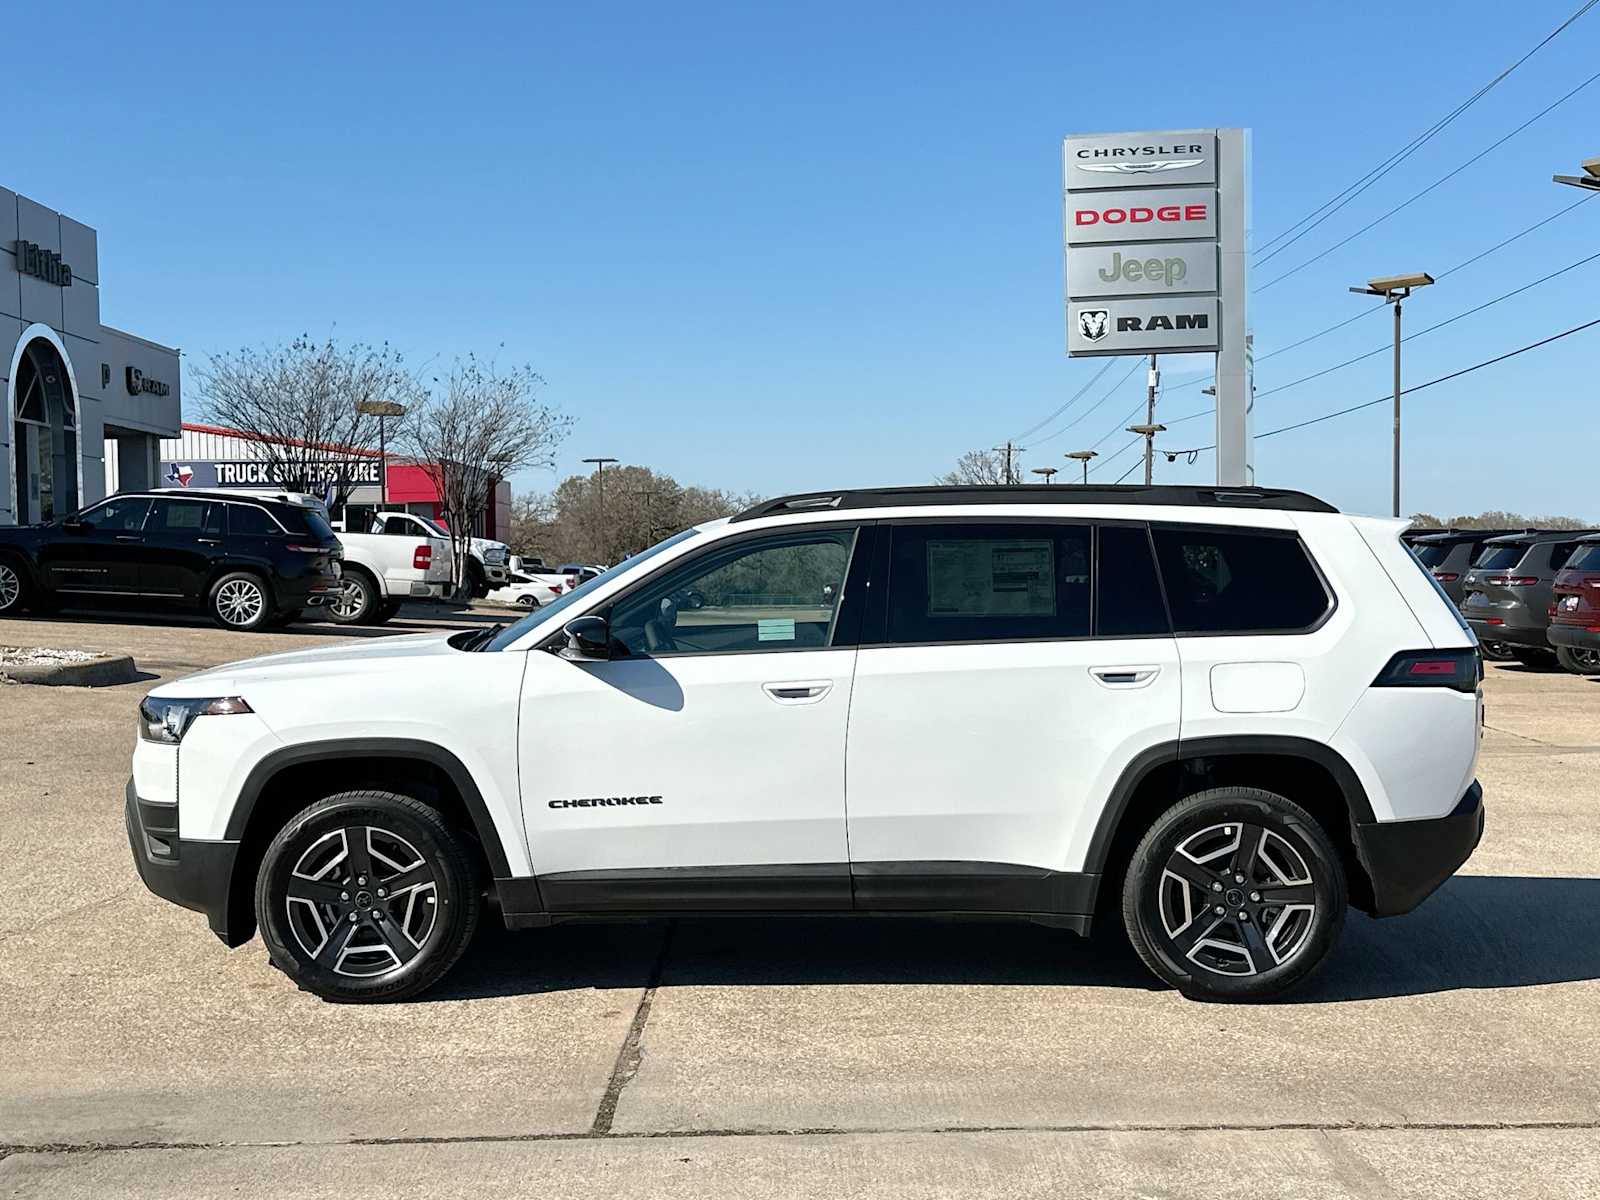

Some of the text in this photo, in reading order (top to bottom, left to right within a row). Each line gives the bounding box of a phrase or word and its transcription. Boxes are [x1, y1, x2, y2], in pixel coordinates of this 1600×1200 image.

[1077, 145, 1203, 159] CHRYSLER
[1075, 205, 1207, 226] DODGE
[1098, 252, 1187, 287] Jeep
[1117, 314, 1208, 331] RAM
[214, 463, 269, 484] TRUCK
[548, 796, 663, 808] CHEROKEE
